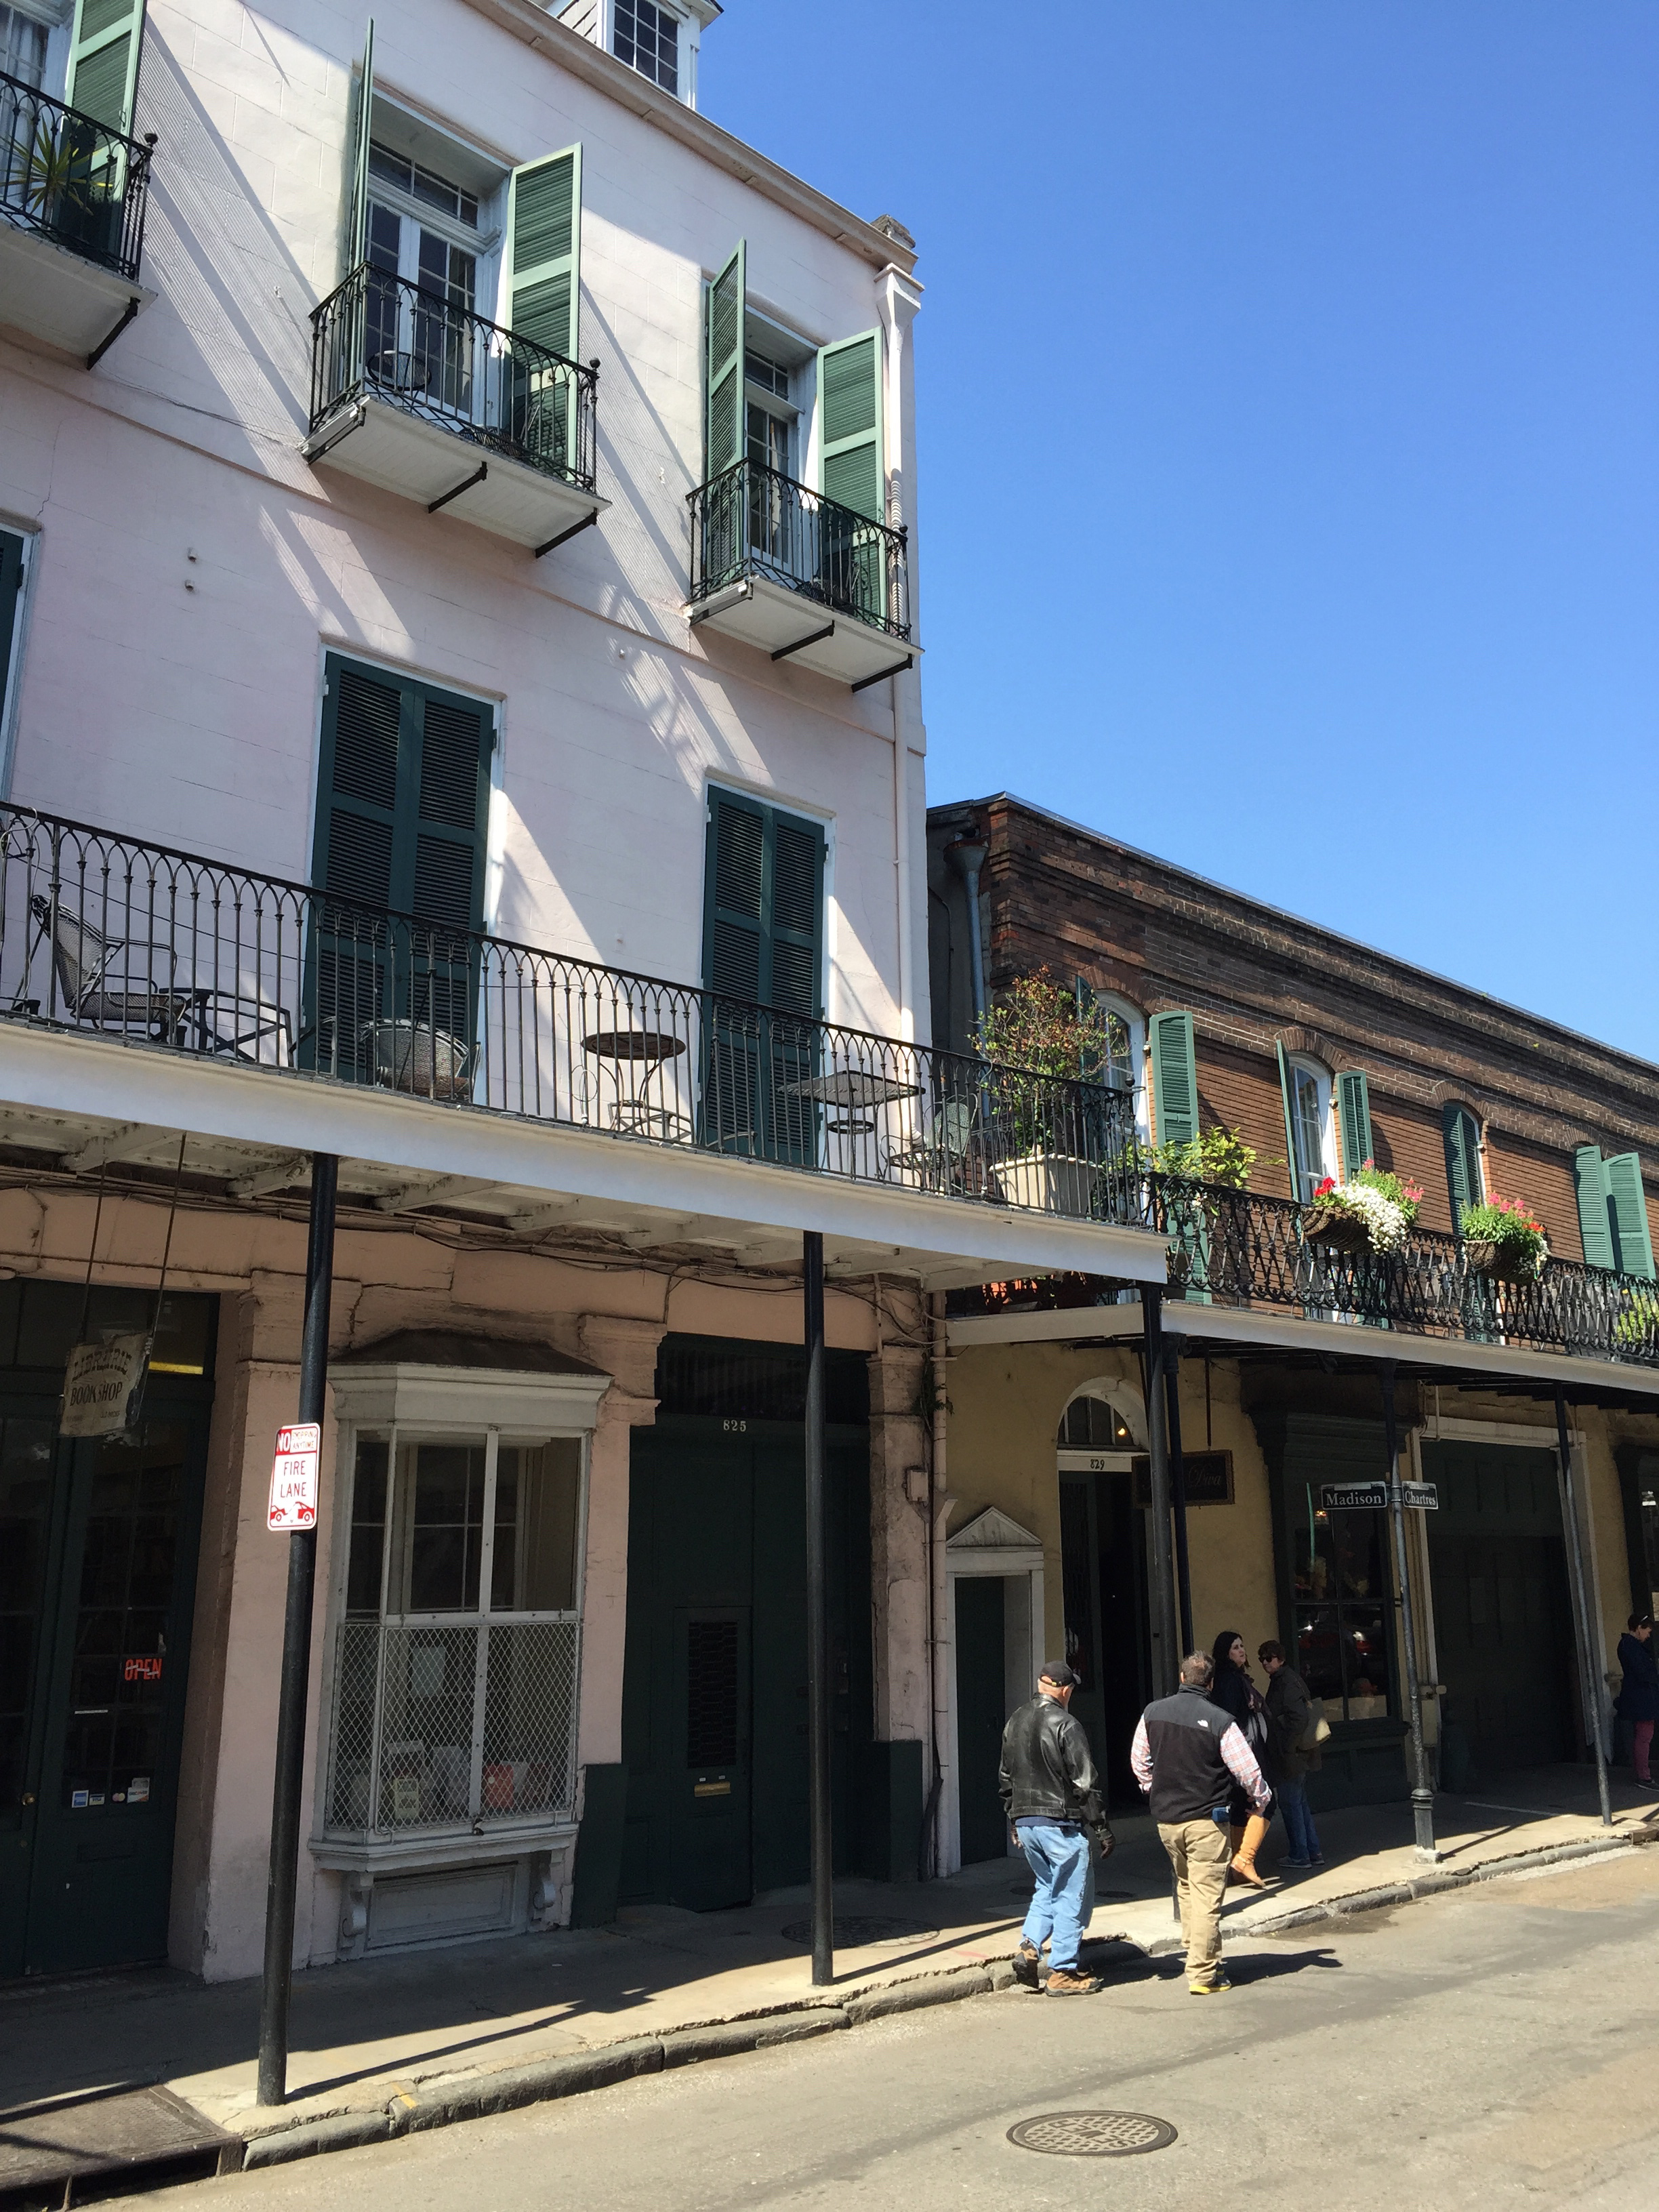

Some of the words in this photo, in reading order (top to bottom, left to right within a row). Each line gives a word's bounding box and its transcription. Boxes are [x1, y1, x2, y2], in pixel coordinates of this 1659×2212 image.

[723, 1419, 747, 1432] 825
[276, 1432, 291, 1452] NO
[293, 1441, 314, 1450] ANYTIME
[283, 1460, 306, 1476] FIRE
[1090, 1458, 1105, 1470] 829
[281, 1482, 307, 1498] LANE
[1405, 1490, 1436, 1506] Chartres
[1326, 1492, 1382, 1506] Madison
[125, 1658, 163, 1681] OPEN
